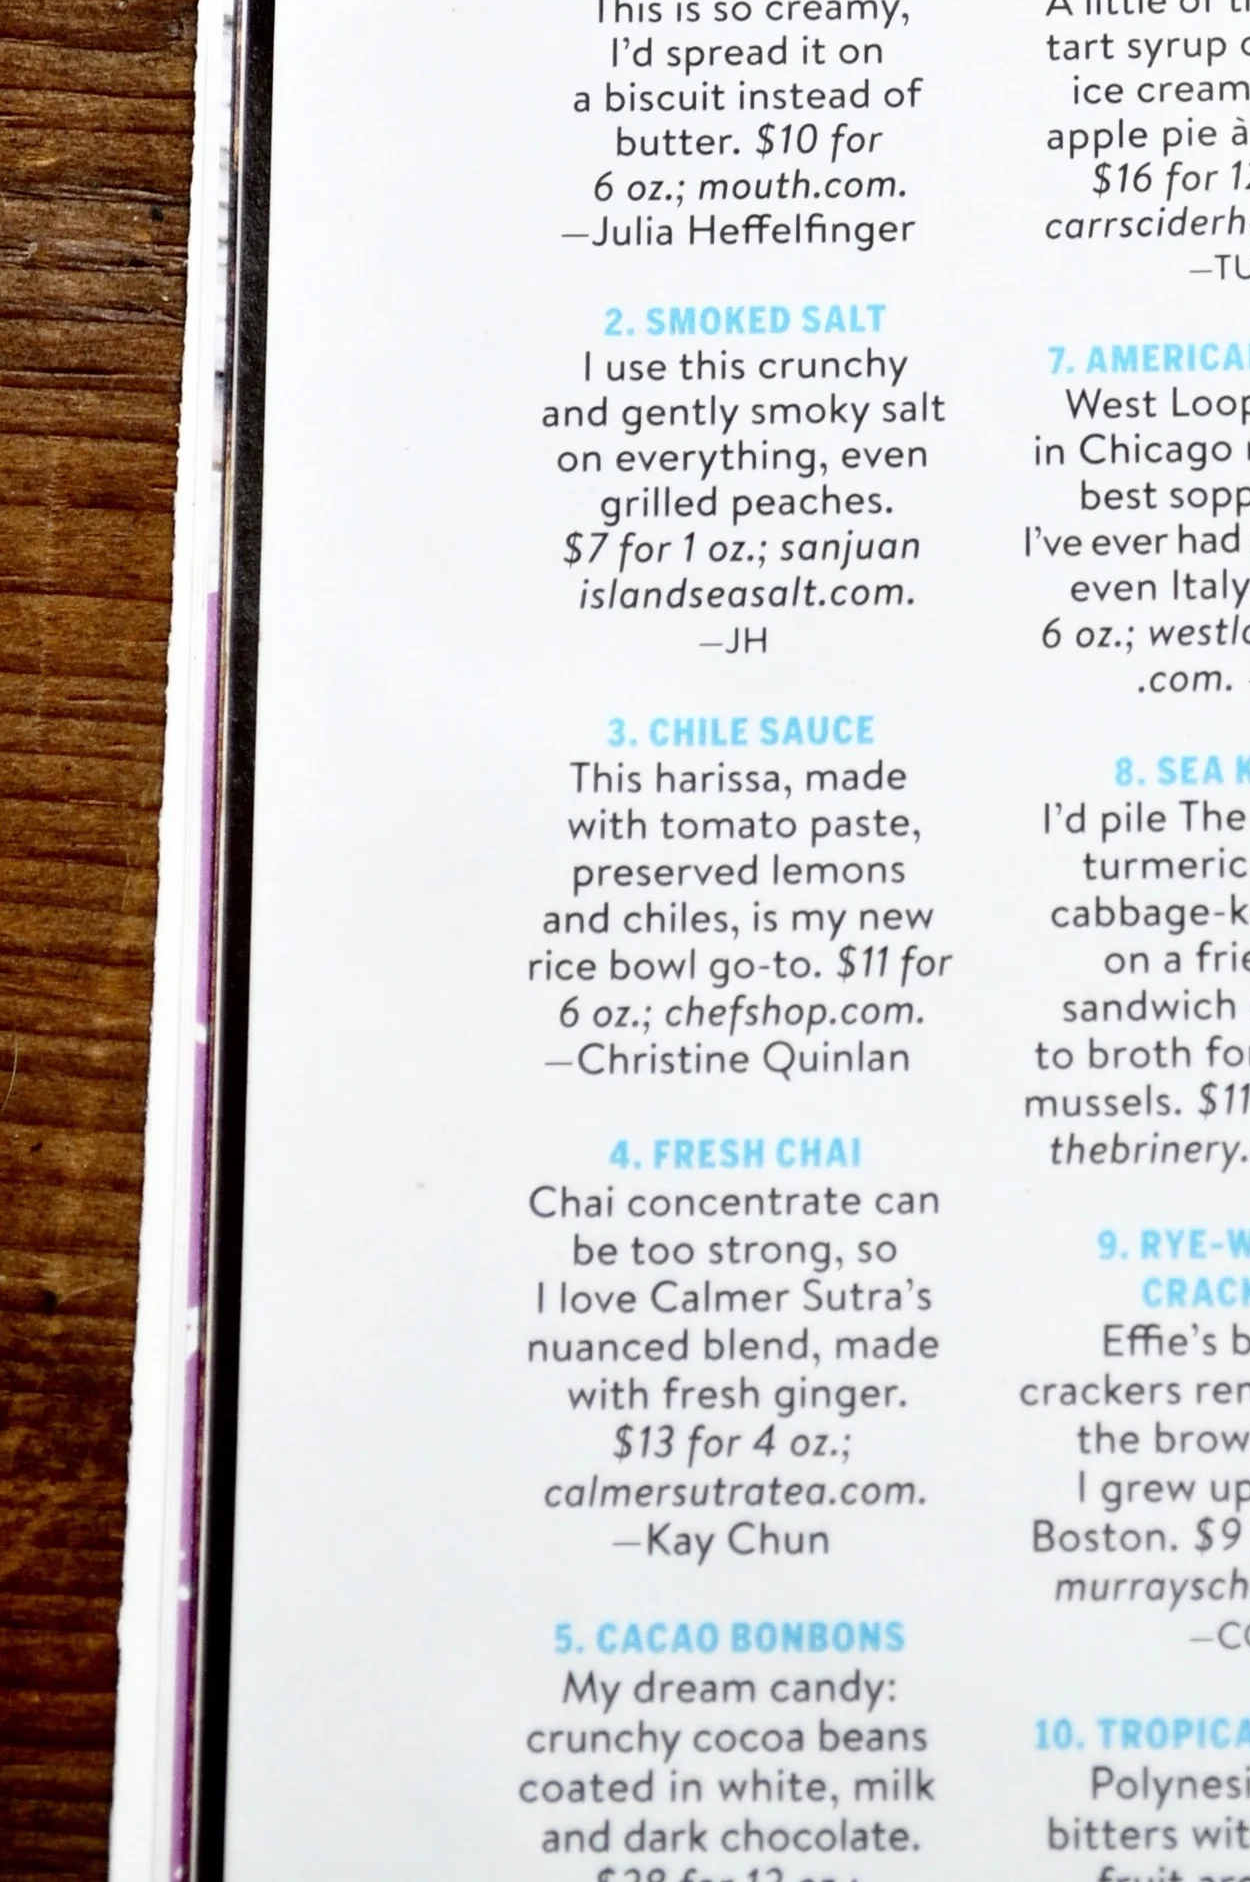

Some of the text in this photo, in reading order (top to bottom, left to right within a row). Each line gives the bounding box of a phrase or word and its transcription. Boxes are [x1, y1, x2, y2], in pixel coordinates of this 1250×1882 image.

[714, 0, 752, 22] so
[612, 34, 882, 77] I’d spread it on
[1046, 32, 1114, 61] tart
[1128, 36, 1227, 68] syrup
[574, 76, 924, 113] a biscuit instead of
[1073, 74, 1124, 105] ice
[1137, 79, 1250, 103] cream
[617, 121, 883, 164] butter. $10 for
[1047, 117, 1148, 159] apple
[1163, 116, 1217, 157] pie
[1231, 115, 1248, 146] à
[594, 167, 906, 208] 6 oz.; mouth.com.
[1092, 160, 1152, 199] $16
[1166, 160, 1219, 202] for
[689, 211, 916, 252] Heffelfinger
[604, 303, 886, 336] 2. SMOKED SALT
[1048, 345, 1074, 374] 7.
[608, 713, 874, 747] 3. CHILE SAUCE
[1115, 755, 1145, 786] 8.
[1157, 754, 1224, 786] SEA
[1045, 801, 1085, 834] I’d
[1102, 800, 1166, 844] pile
[1179, 799, 1246, 832] The
[1104, 951, 1149, 974] on
[1164, 950, 1181, 974] a
[1063, 987, 1236, 1022] sandwich
[1035, 1041, 1073, 1070] to
[1089, 1035, 1191, 1069] broth
[1025, 1083, 1181, 1117] mussels.
[1198, 1080, 1250, 1120] $11
[609, 1136, 861, 1170] 4. FRESH CHAI
[1098, 1228, 1128, 1260] 9.
[555, 1619, 905, 1654] 5. CACAO BONBONS
[563, 1667, 895, 1714] My dream candy:
[526, 1717, 928, 1764] crunchy cocoa beans
[1036, 1716, 1084, 1750] 10.
[519, 1766, 934, 1809] coated in white, milk
[542, 1817, 920, 1854] and dark chocolate.
[1048, 1815, 1178, 1851] bitters
